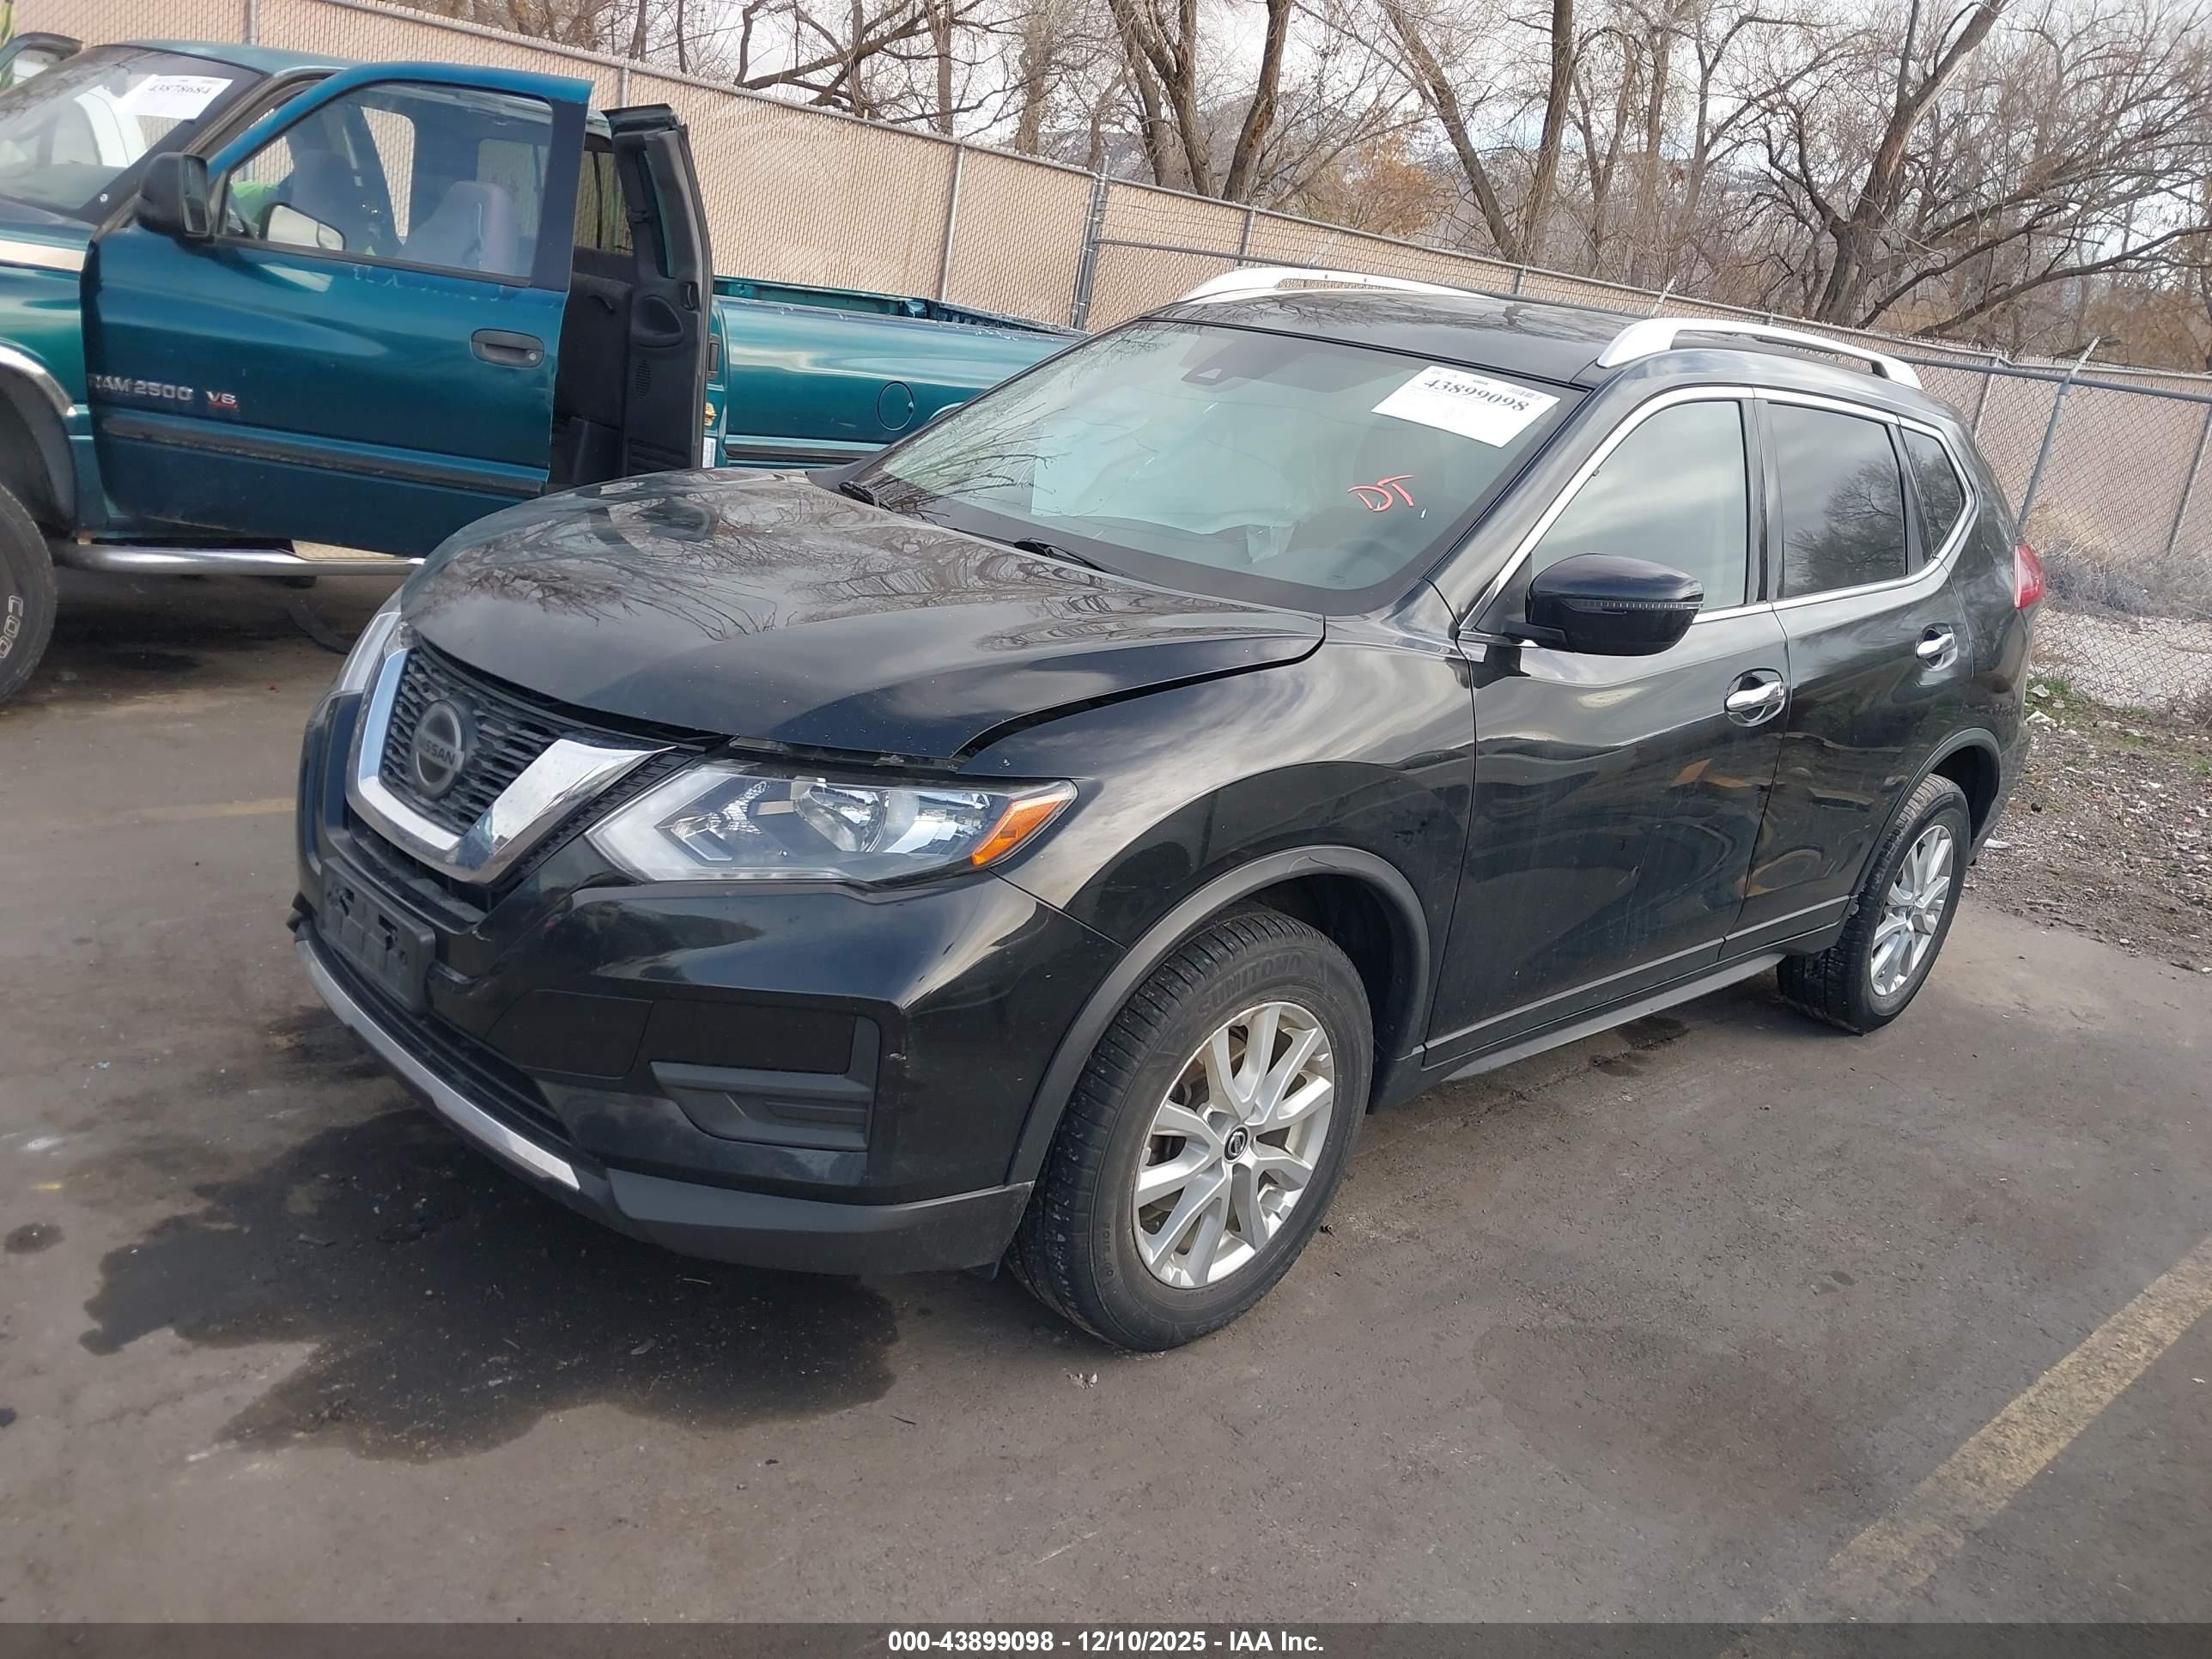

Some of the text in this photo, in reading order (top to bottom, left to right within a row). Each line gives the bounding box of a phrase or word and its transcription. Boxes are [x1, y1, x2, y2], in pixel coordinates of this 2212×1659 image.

[133, 380, 193, 401] 2500
[1424, 379, 1529, 412] 43899098
[1346, 474, 1415, 513] DT
